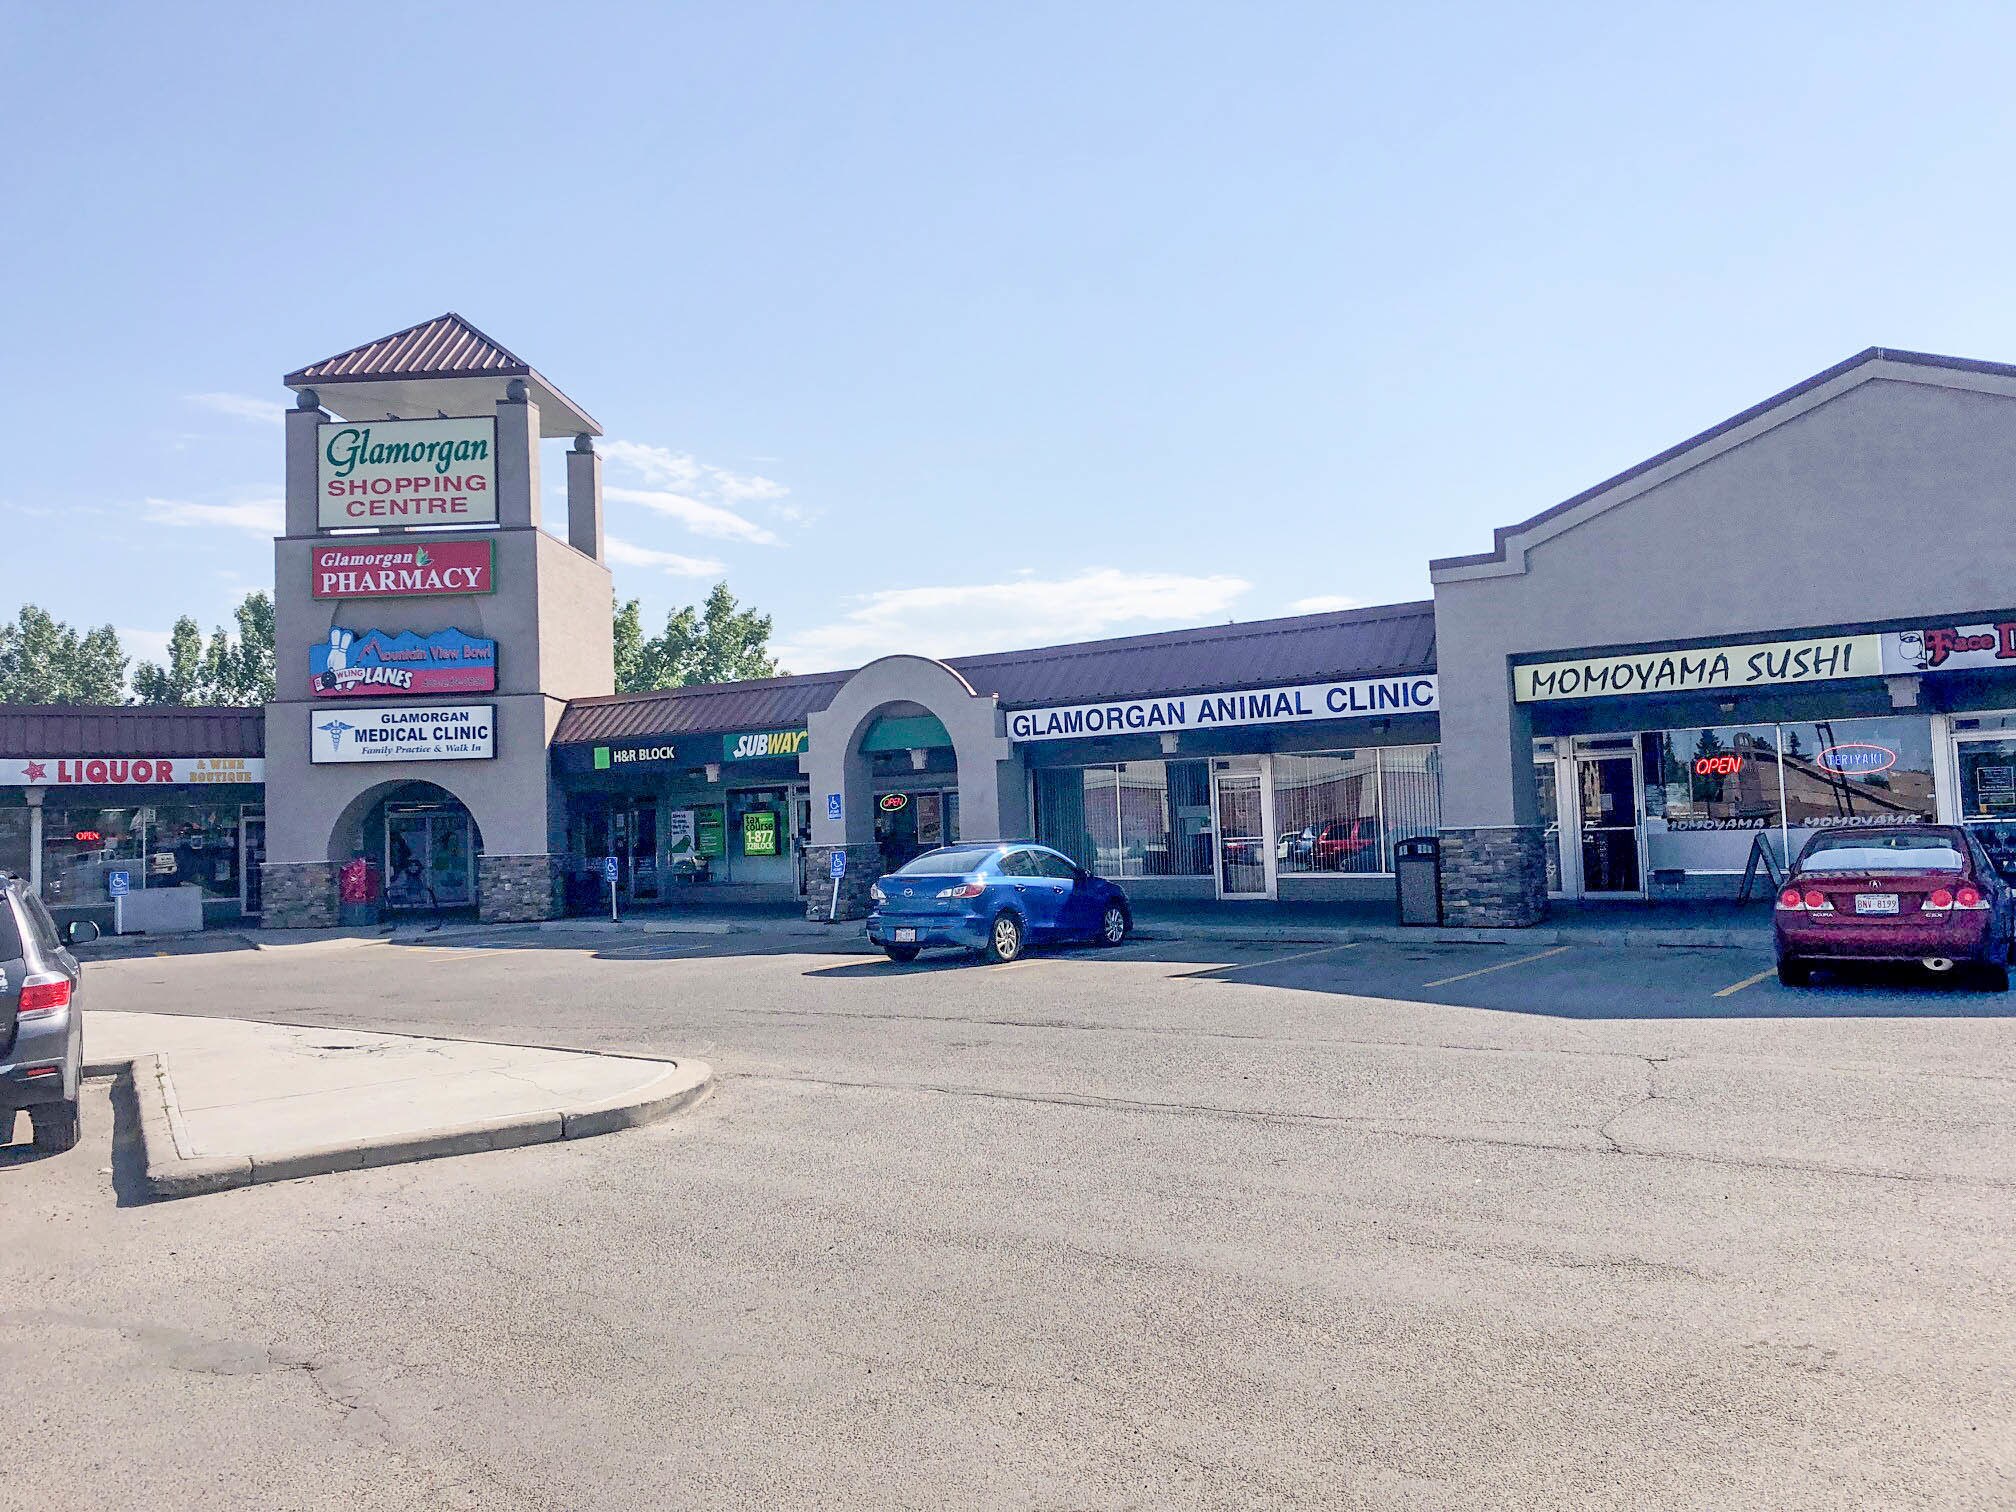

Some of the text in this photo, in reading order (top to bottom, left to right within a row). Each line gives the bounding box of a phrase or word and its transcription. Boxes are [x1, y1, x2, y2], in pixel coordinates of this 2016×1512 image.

[326, 428, 488, 477] Glamorgan
[328, 475, 487, 496] SHOPPING
[346, 497, 468, 517] CENTRE
[320, 552, 413, 568] Glamorgan
[321, 567, 482, 593] PHARMACY
[356, 638, 490, 662] Mountain View Bowl
[1531, 643, 1853, 696] MOMOYAMA SUSHI
[365, 667, 413, 689] LANES
[1012, 680, 1434, 737] GLAMORGAN ANIMAL CLINIC
[381, 711, 469, 724] GLAMORGAN
[355, 725, 488, 742] MEDICAL CLINIC
[361, 743, 481, 756] Family Practice & Walk In
[733, 730, 808, 759] SUBWAY
[613, 746, 675, 762] H&R BLOCK
[1828, 752, 1883, 767] TERIYAKI
[58, 760, 174, 783] LIQUOR
[210, 759, 245, 770] WINE
[1696, 756, 1742, 775] OPEN
[189, 772, 252, 782] BOUTIQUE
[884, 796, 903, 806] OPEN
[746, 815, 760, 824] tax
[746, 822, 774, 831] course
[75, 831, 100, 840] OPEN
[746, 830, 774, 843] 1-877
